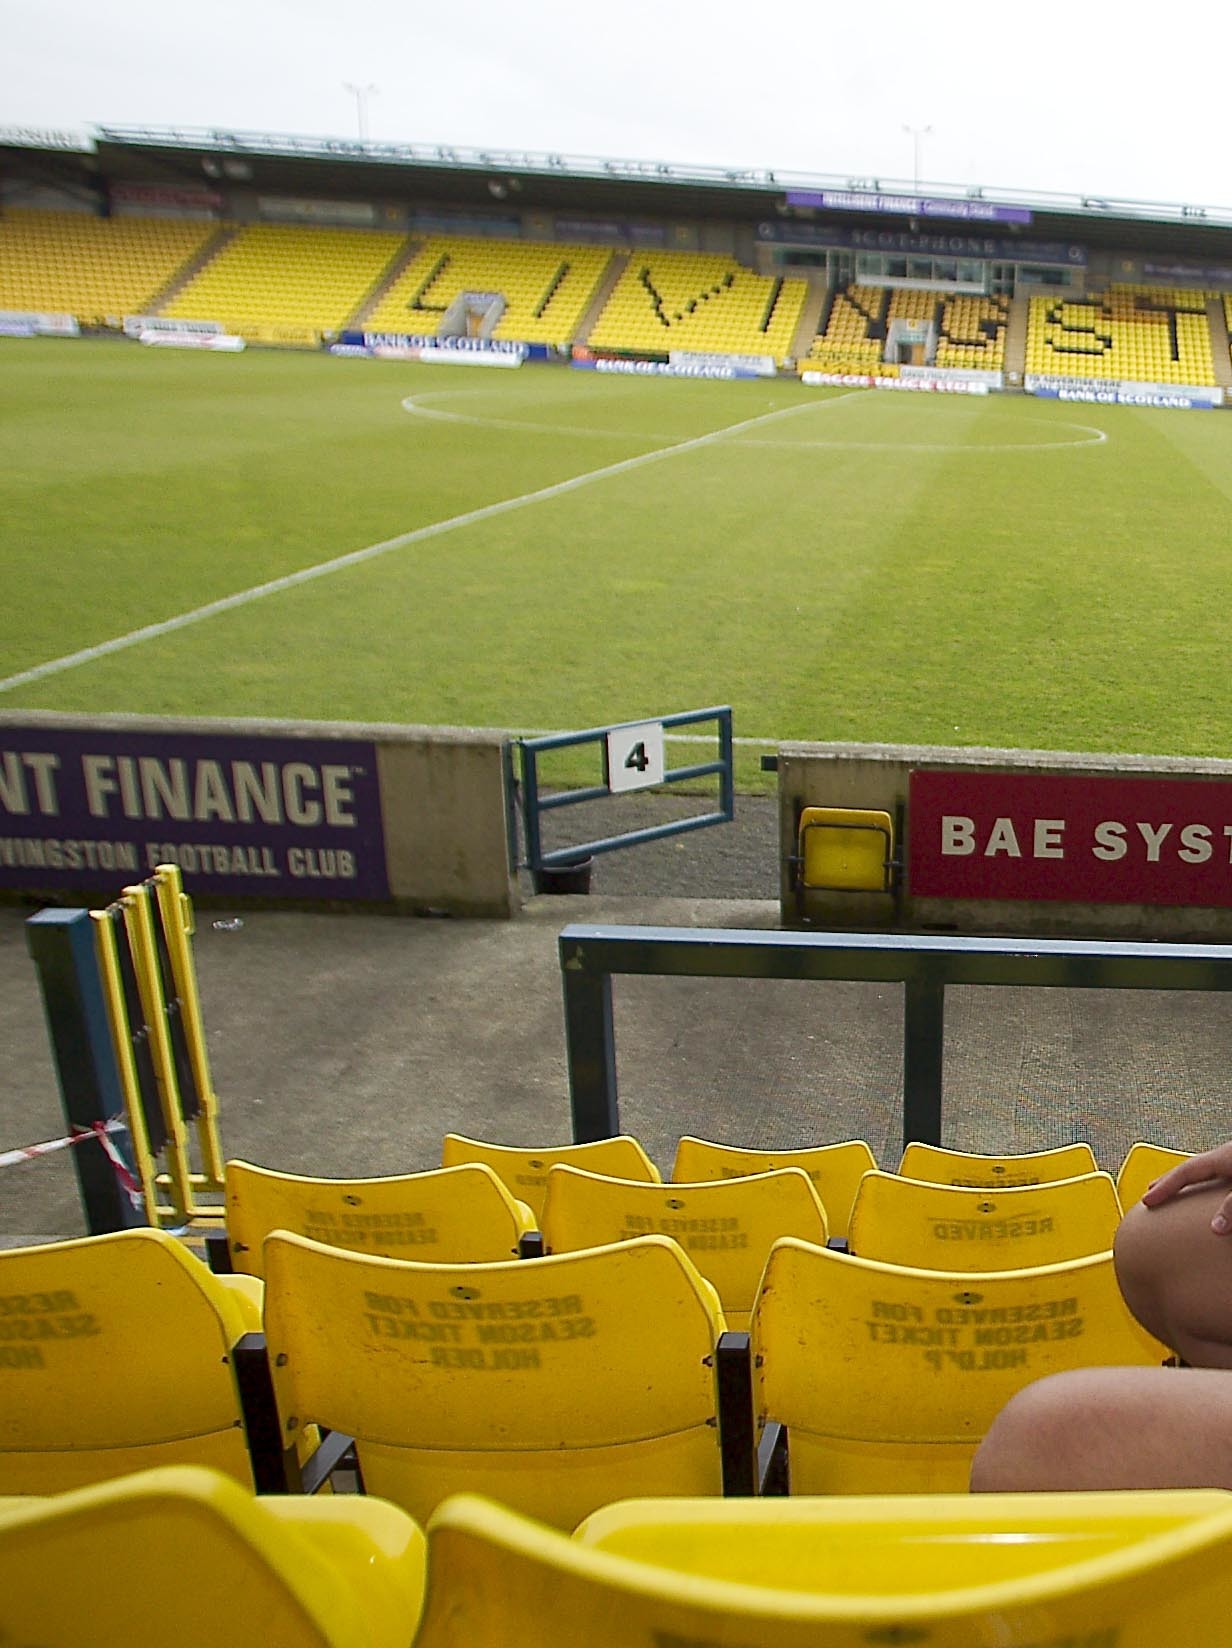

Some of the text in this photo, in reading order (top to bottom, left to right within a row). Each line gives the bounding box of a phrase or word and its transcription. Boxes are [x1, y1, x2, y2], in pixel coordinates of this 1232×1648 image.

[364, 333, 411, 348] BANK
[1058, 390, 1095, 401] BANK
[623, 741, 650, 772] 4
[940, 815, 1067, 859] BAE
[145, 842, 281, 877] FOOTBALL
[287, 848, 357, 879] CLUB
